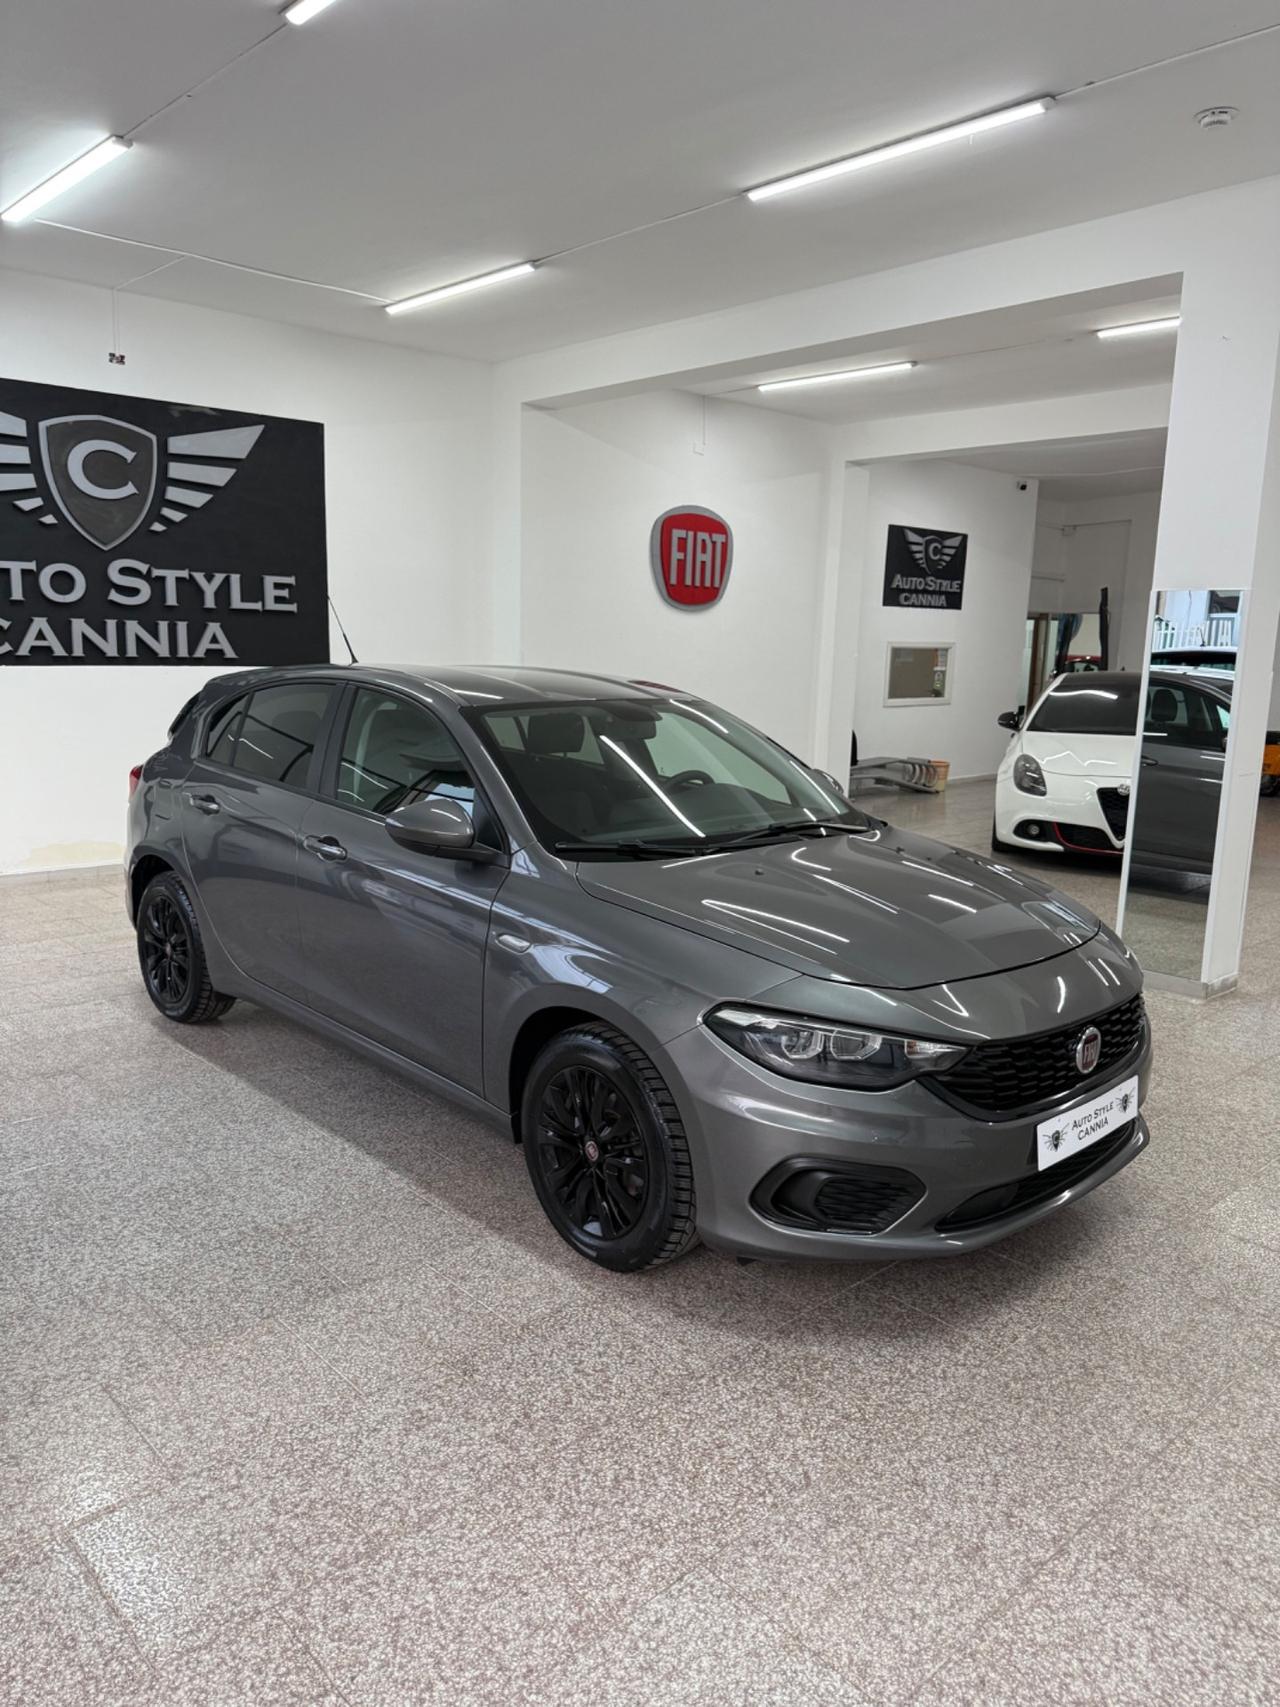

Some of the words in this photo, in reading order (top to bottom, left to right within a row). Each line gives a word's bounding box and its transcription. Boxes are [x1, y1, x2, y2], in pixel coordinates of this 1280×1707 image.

[669, 528, 727, 589] FIAT
[107, 558, 298, 613] STYLE
[891, 573, 925, 589] AUTO
[925, 576, 962, 593] STYLE
[899, 592, 947, 607] CANNIA
[0, 616, 239, 659] ANNIA
[1071, 1113, 1093, 1131] AUTO
[1077, 1117, 1109, 1141] CANNIA
